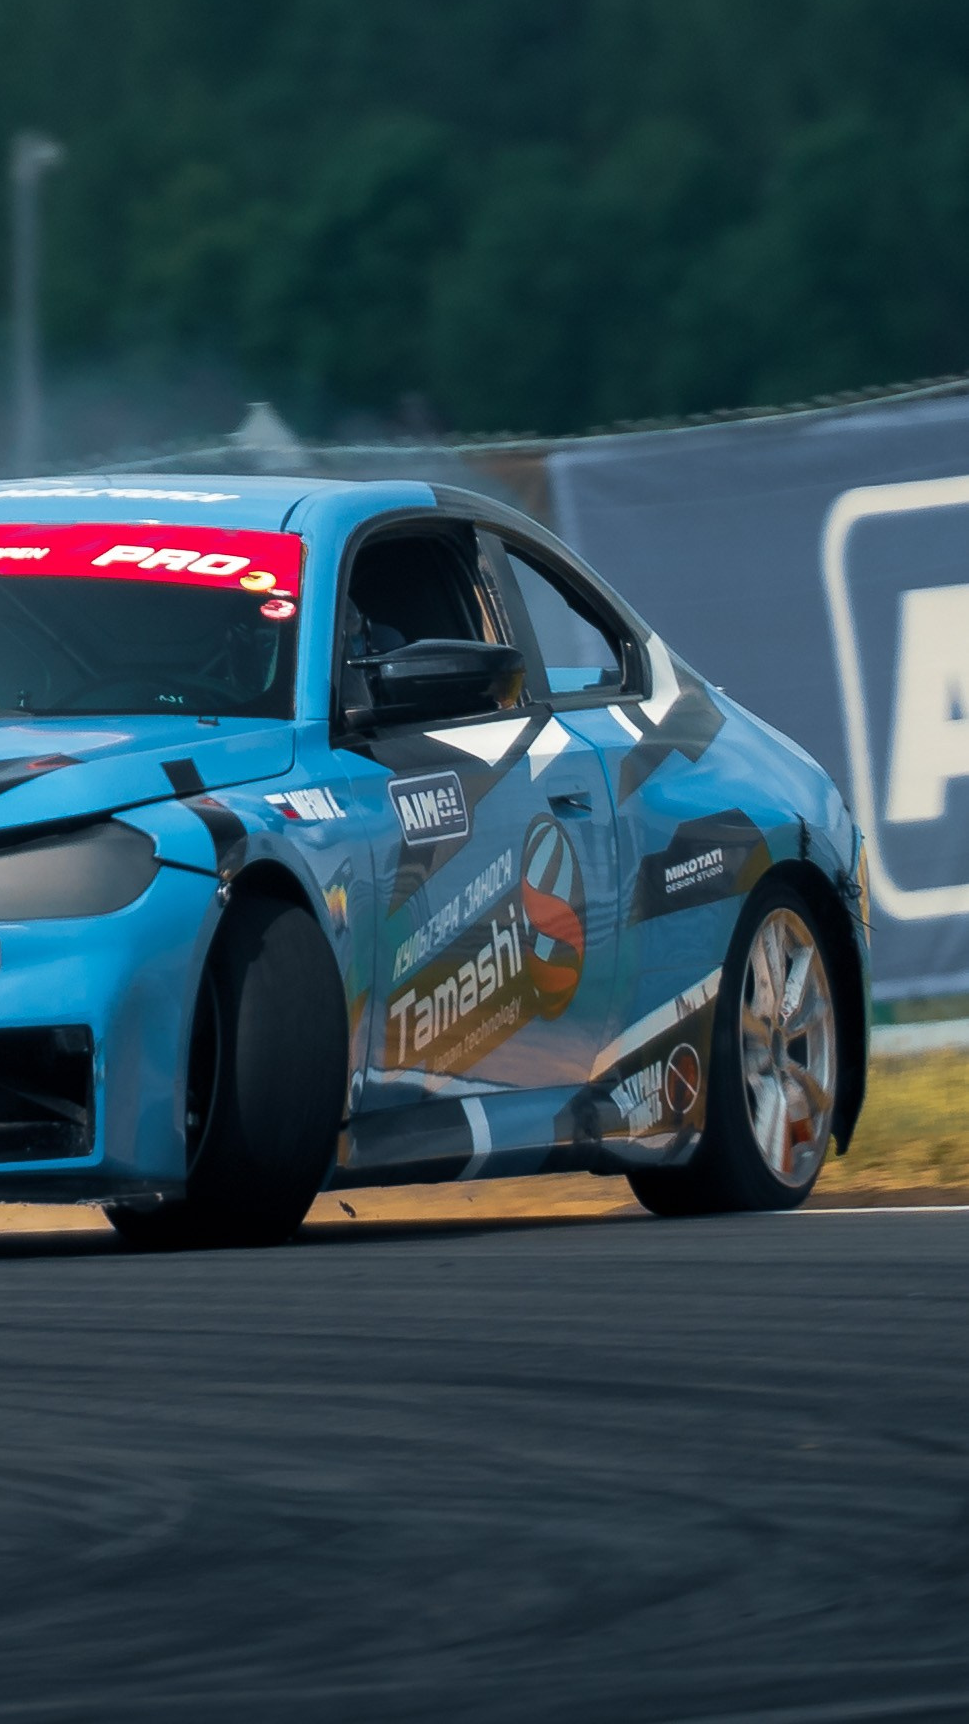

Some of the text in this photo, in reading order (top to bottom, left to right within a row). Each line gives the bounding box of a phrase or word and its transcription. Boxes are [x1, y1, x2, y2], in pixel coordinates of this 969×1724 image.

[90, 544, 251, 576] PRO
[397, 786, 464, 831] AIMOL
[664, 847, 723, 883] MIKOTATI
[665, 864, 724, 894] DESIGN STUDIO
[391, 848, 513, 983] КУЛЬТУРА ЗАНОСА
[389, 902, 523, 1065] Tamashi
